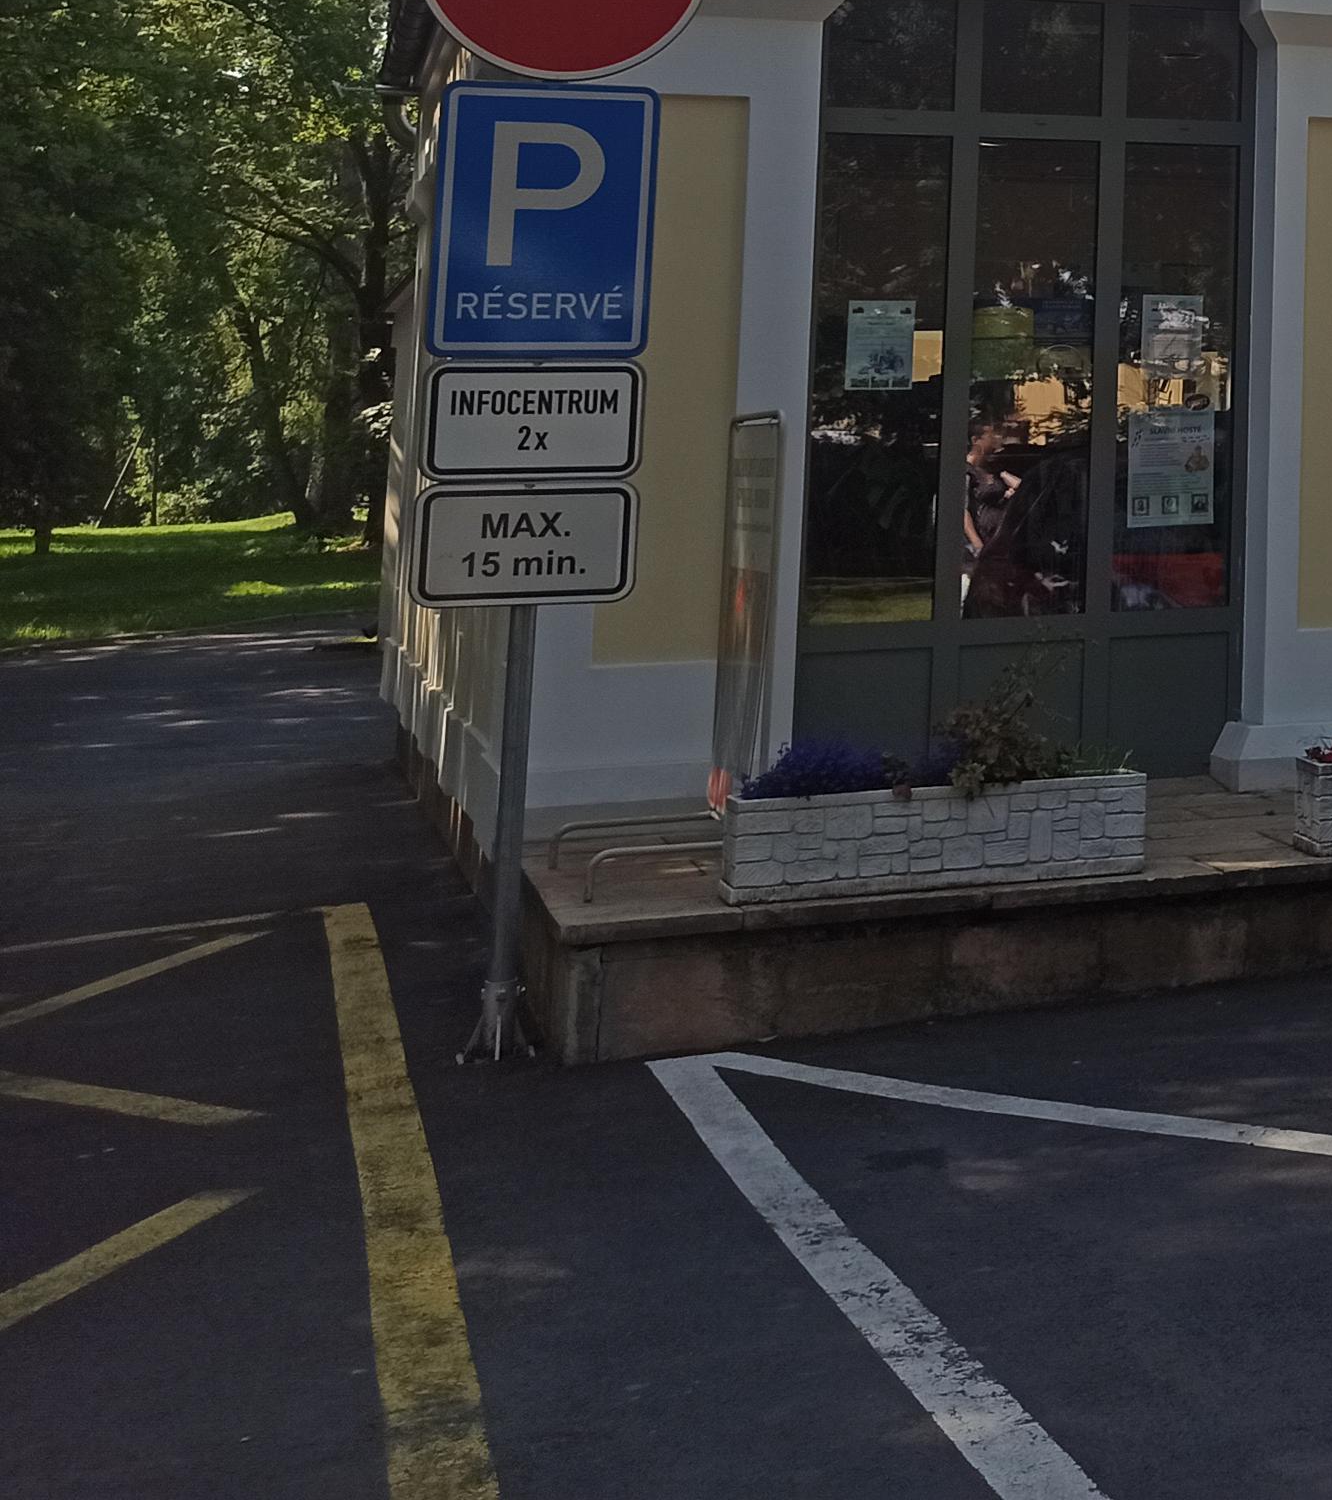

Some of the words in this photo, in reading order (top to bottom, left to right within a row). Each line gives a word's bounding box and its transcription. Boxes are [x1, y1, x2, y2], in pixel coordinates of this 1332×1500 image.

[485, 120, 605, 267] P
[455, 285, 624, 322] RÉSERVÉ
[450, 388, 619, 417] INFOCENTRUM
[517, 426, 548, 452] 2x
[480, 512, 571, 541] MAX.
[461, 552, 504, 578] 15
[514, 550, 586, 578] min.
